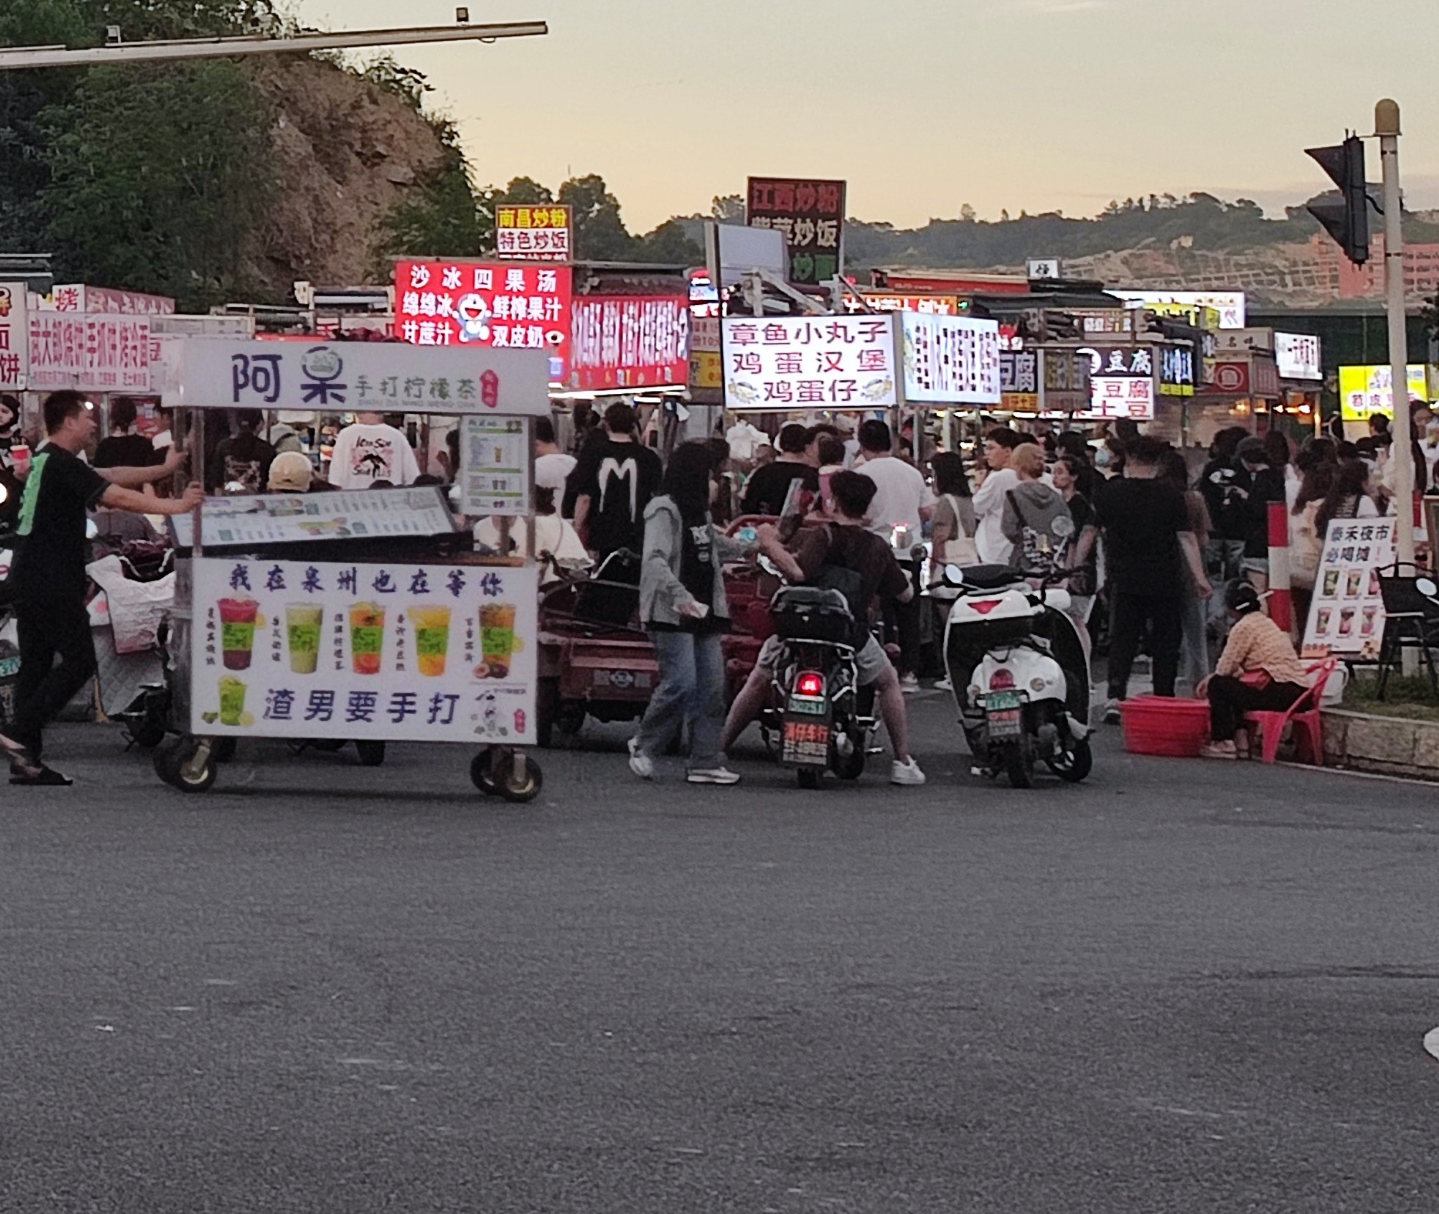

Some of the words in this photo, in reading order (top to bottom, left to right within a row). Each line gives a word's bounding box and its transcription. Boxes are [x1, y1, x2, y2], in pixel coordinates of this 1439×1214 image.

[752, 182, 838, 213] 江西炒粉
[499, 208, 567, 228] 南昌炒粉
[499, 231, 567, 251] 特色炒饭
[410, 265, 557, 292] 沙冰四果汤
[55, 287, 79, 312] 烤
[402, 291, 453, 318] 绵绵冰
[492, 295, 563, 321] 鲜榨果汁
[402, 319, 454, 346] 甘蔗汁
[492, 324, 544, 349] 双皮奶
[729, 320, 888, 347] 章鱼小丸子
[732, 348, 888, 374] 鸡蛋汉堡
[1104, 348, 1152, 374] 豆腐
[355, 374, 477, 400] 手打柠檬茶
[763, 378, 859, 403] 鸡蛋仔
[1330, 525, 1390, 543] 泰禾夜市
[229, 563, 504, 598] 我在泉州也在等你
[262, 688, 460, 725] 渣男要手打
